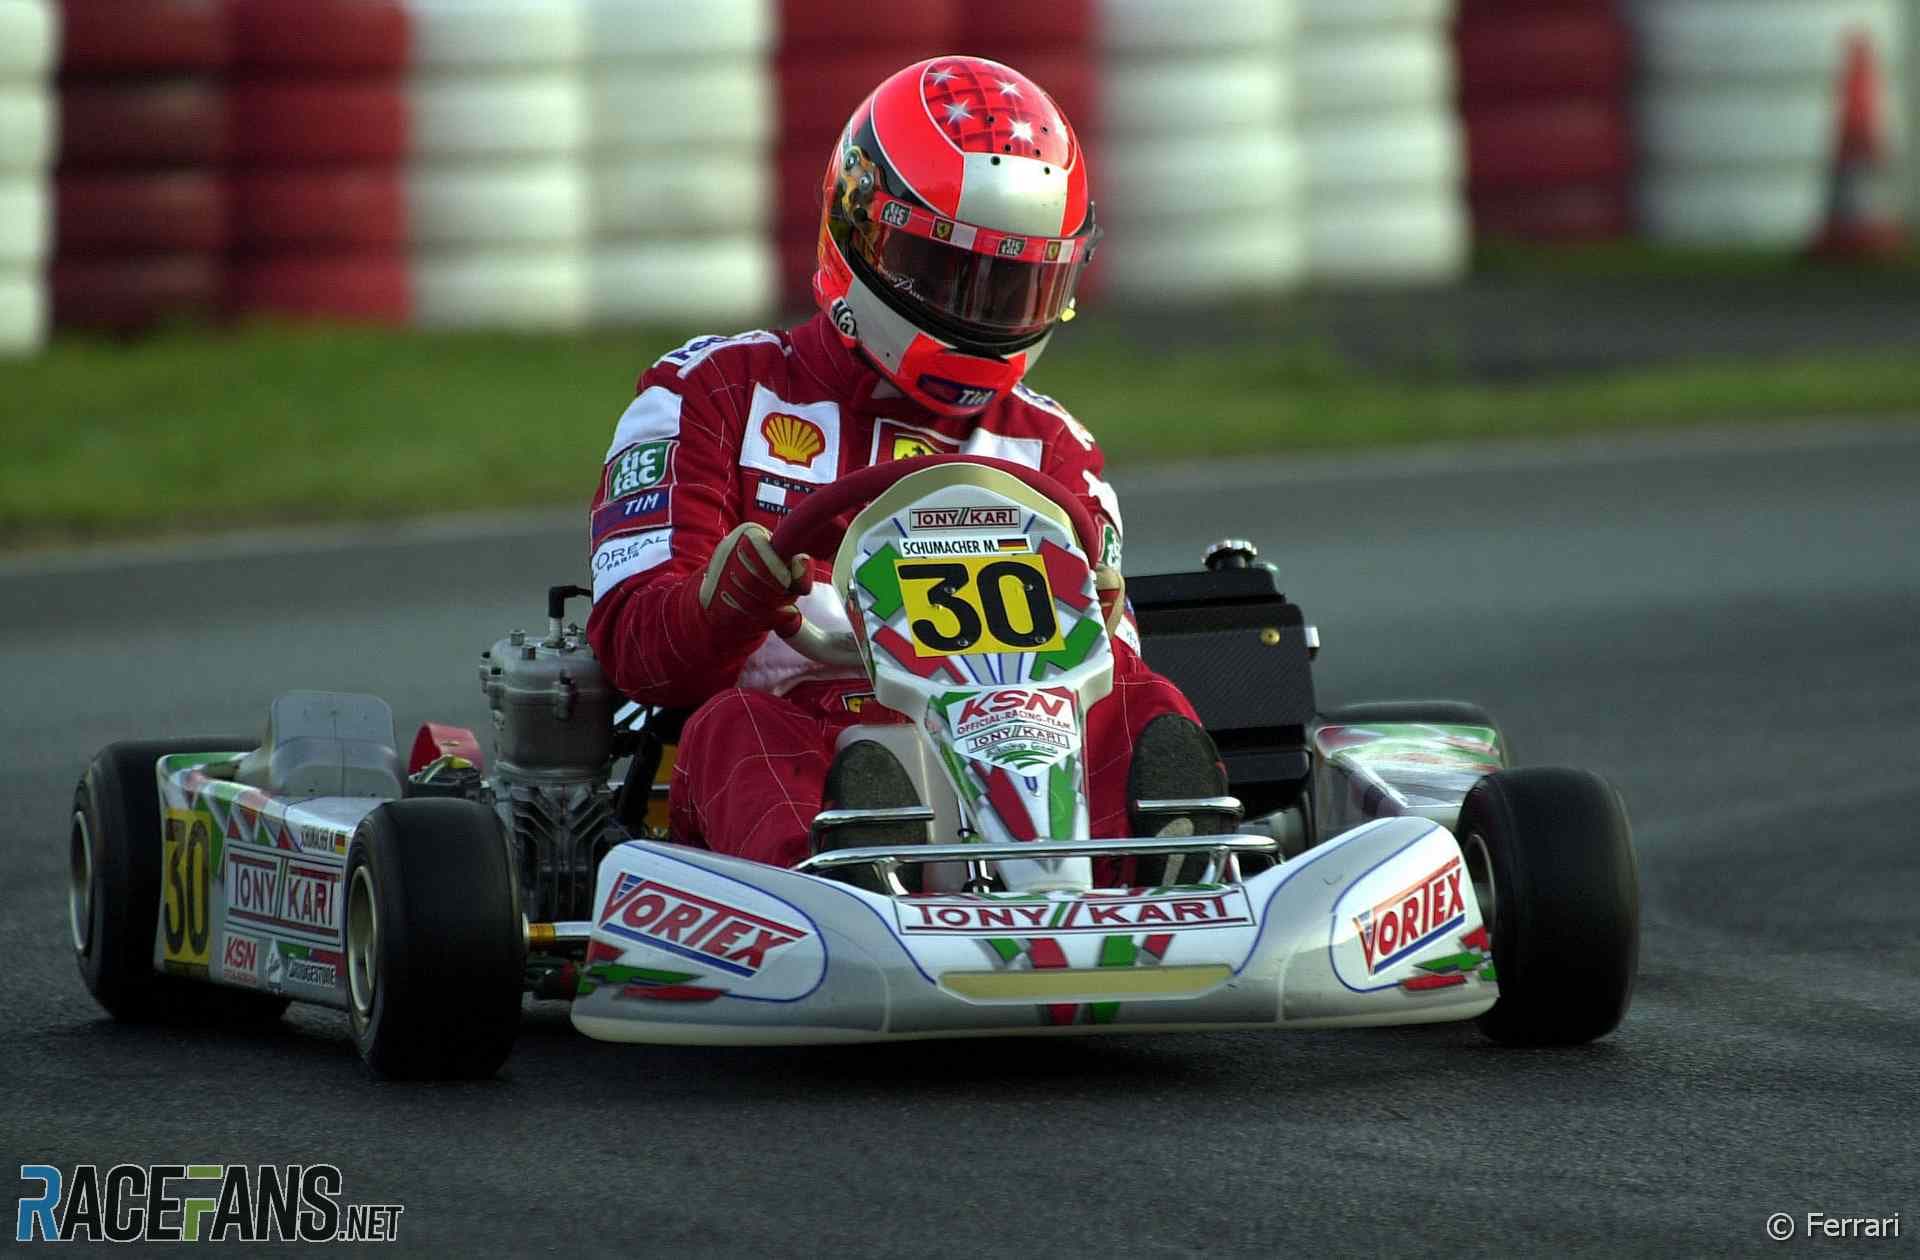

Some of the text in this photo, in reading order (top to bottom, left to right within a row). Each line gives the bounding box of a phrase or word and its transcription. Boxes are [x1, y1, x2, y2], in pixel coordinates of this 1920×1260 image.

[620, 448, 656, 473] tic
[613, 465, 656, 496] tac
[624, 493, 660, 515] TIM
[918, 509, 1012, 528] TONY KART
[903, 541, 980, 555] SCHUMACHER
[897, 560, 1057, 652] 30
[958, 690, 1064, 725] KSN
[973, 727, 1011, 747] TONY
[165, 817, 210, 956] 30
[232, 855, 339, 926] TONY KART
[598, 872, 808, 969] VORTEX
[917, 895, 1230, 928] TONY KART
[1352, 856, 1465, 976] VORTEX
[224, 935, 257, 970] KSN
